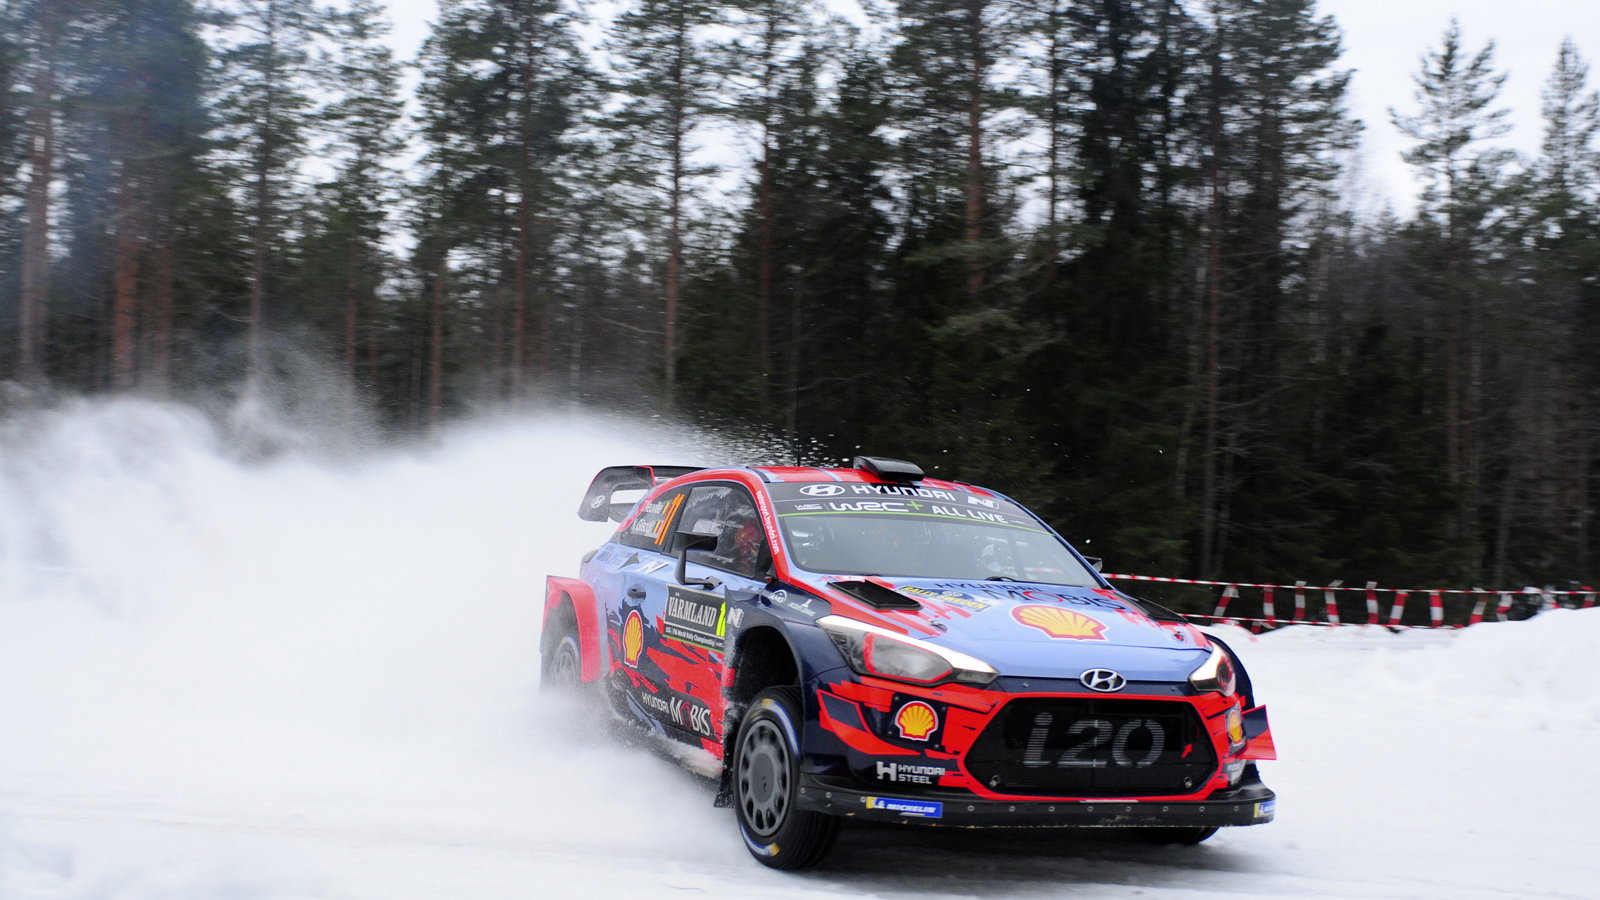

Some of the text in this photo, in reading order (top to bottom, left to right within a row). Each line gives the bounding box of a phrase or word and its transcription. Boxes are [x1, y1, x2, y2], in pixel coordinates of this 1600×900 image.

[851, 485, 956, 501] HYUNDAI
[931, 505, 967, 517] ALL
[967, 509, 1008, 524] LIVE
[902, 586, 939, 597] RALLY
[935, 583, 1044, 592] HYUNDAI
[981, 589, 1126, 610] MOBIS
[668, 592, 717, 627] VÄRMLAND
[641, 691, 711, 736] HYUNDAI MOBIS
[1023, 712, 1165, 768] i20
[898, 764, 946, 776] HYUNDAI
[898, 774, 932, 784] STEEL
[886, 803, 937, 813] MICHELIN
